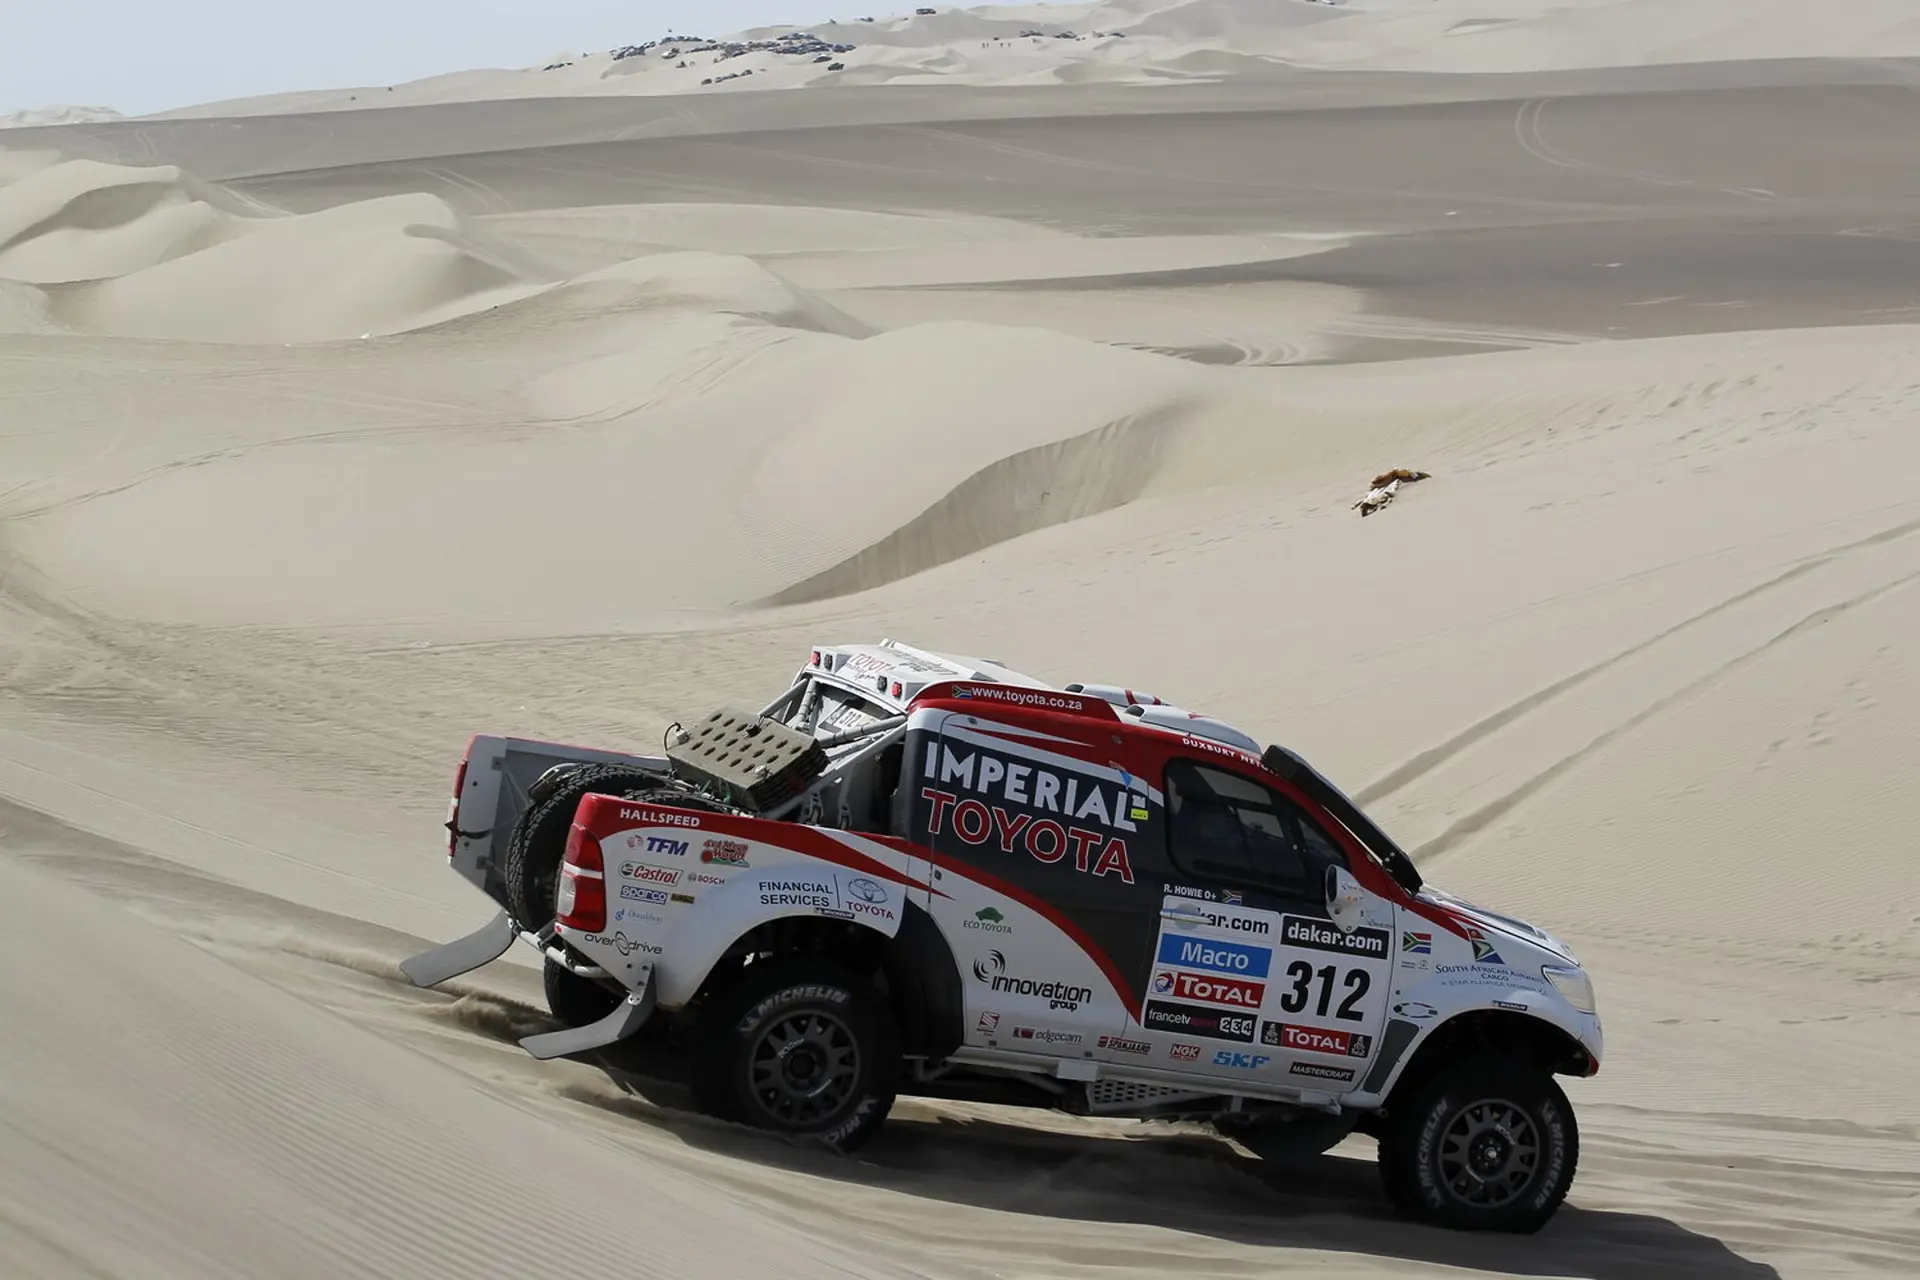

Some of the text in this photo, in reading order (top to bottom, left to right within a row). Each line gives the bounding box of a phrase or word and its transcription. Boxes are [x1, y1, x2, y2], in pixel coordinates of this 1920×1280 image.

[971, 685, 1083, 711] www.toyota.co.za
[839, 708, 863, 728] 312
[1182, 737, 1236, 758] DUXBURY
[923, 740, 1138, 833] IMPERIAL
[619, 808, 700, 828] HALLSPEED
[646, 836, 690, 856] TFM
[921, 787, 1135, 885] TOYOTA
[633, 864, 679, 885] Castrol
[697, 876, 726, 885] BOSCH
[622, 886, 667, 901] sparco
[758, 881, 834, 895] FINANCIAL
[1163, 883, 1173, 894] R.
[1174, 885, 1203, 898] HOWIE
[760, 894, 830, 907] SERVICES
[845, 900, 895, 920] TOYOTA
[962, 920, 1012, 934] ECO TOYOTA
[1287, 922, 1383, 952] dakar.com
[1180, 942, 1250, 969] Macro
[1435, 964, 1469, 974] SOUTH
[1481, 973, 1510, 982] CARGO
[991, 975, 1092, 1004] innovation
[1180, 976, 1259, 1005] TOTAL
[1280, 960, 1372, 1022] 312
[757, 985, 847, 1016] MICHELIN
[1049, 1000, 1078, 1013] group
[1035, 1029, 1083, 1044] edgecam
[1284, 1027, 1346, 1051] TOTAL
[1171, 1044, 1199, 1058] NGK
[1212, 1051, 1271, 1069] SKF
[1291, 1064, 1353, 1081] MASTERCRAFT
[1418, 1099, 1450, 1188] MICHELIN
[1534, 1122, 1565, 1210] MICHELIN
